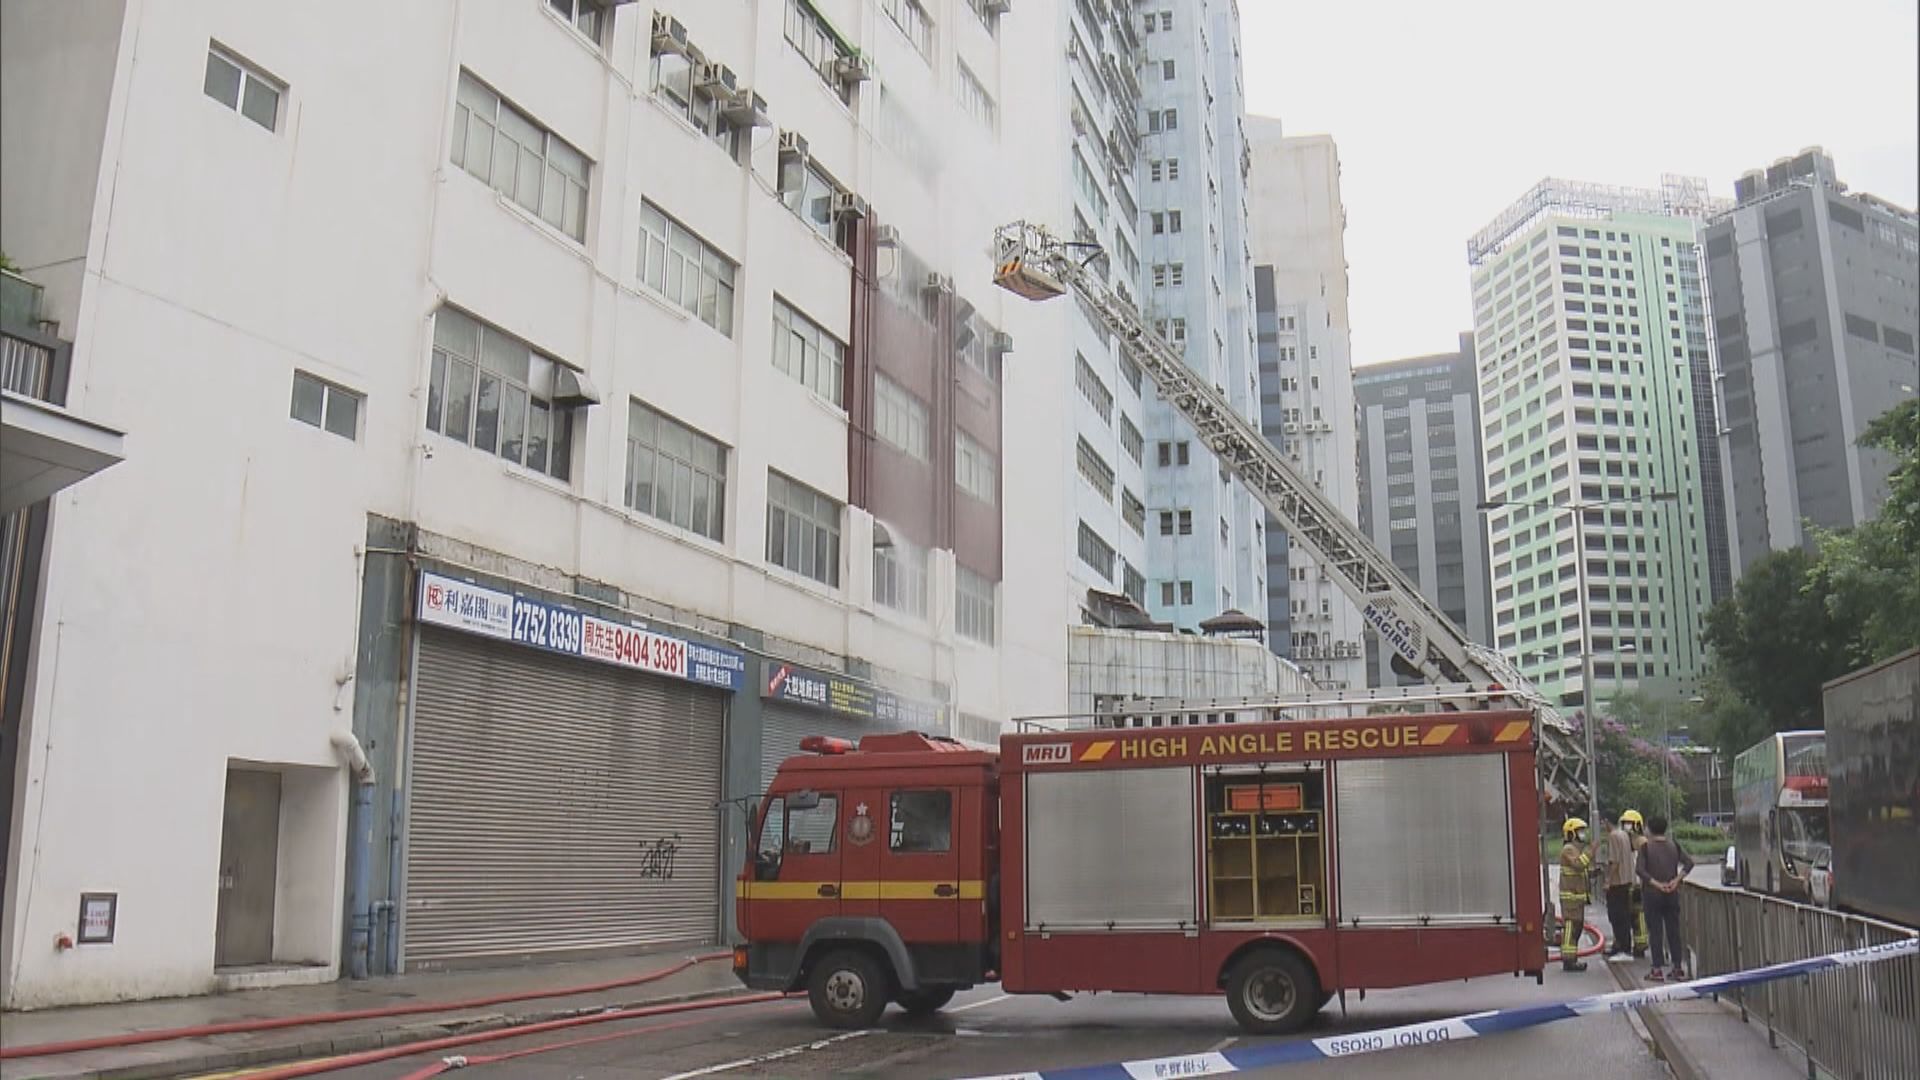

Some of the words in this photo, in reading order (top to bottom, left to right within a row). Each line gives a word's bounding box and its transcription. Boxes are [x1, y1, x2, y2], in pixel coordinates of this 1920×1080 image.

[444, 589, 489, 620] 利嘉閣
[514, 601, 547, 646] 2752
[549, 609, 580, 653] 8339
[1363, 604, 1418, 660] MAGIRUS
[1395, 619, 1411, 637] CS
[584, 621, 614, 652] 周先生
[615, 628, 649, 666] 9404
[654, 638, 684, 674] 3381
[1025, 746, 1067, 762] MRU
[1121, 736, 1187, 759] HIGH
[1199, 731, 1293, 756] ANGLE
[1303, 725, 1420, 750] RESCUE
[1330, 1035, 1383, 1055] CROSS
[1392, 1031, 1423, 1046] NOT
[1426, 1027, 1450, 1041] DO
